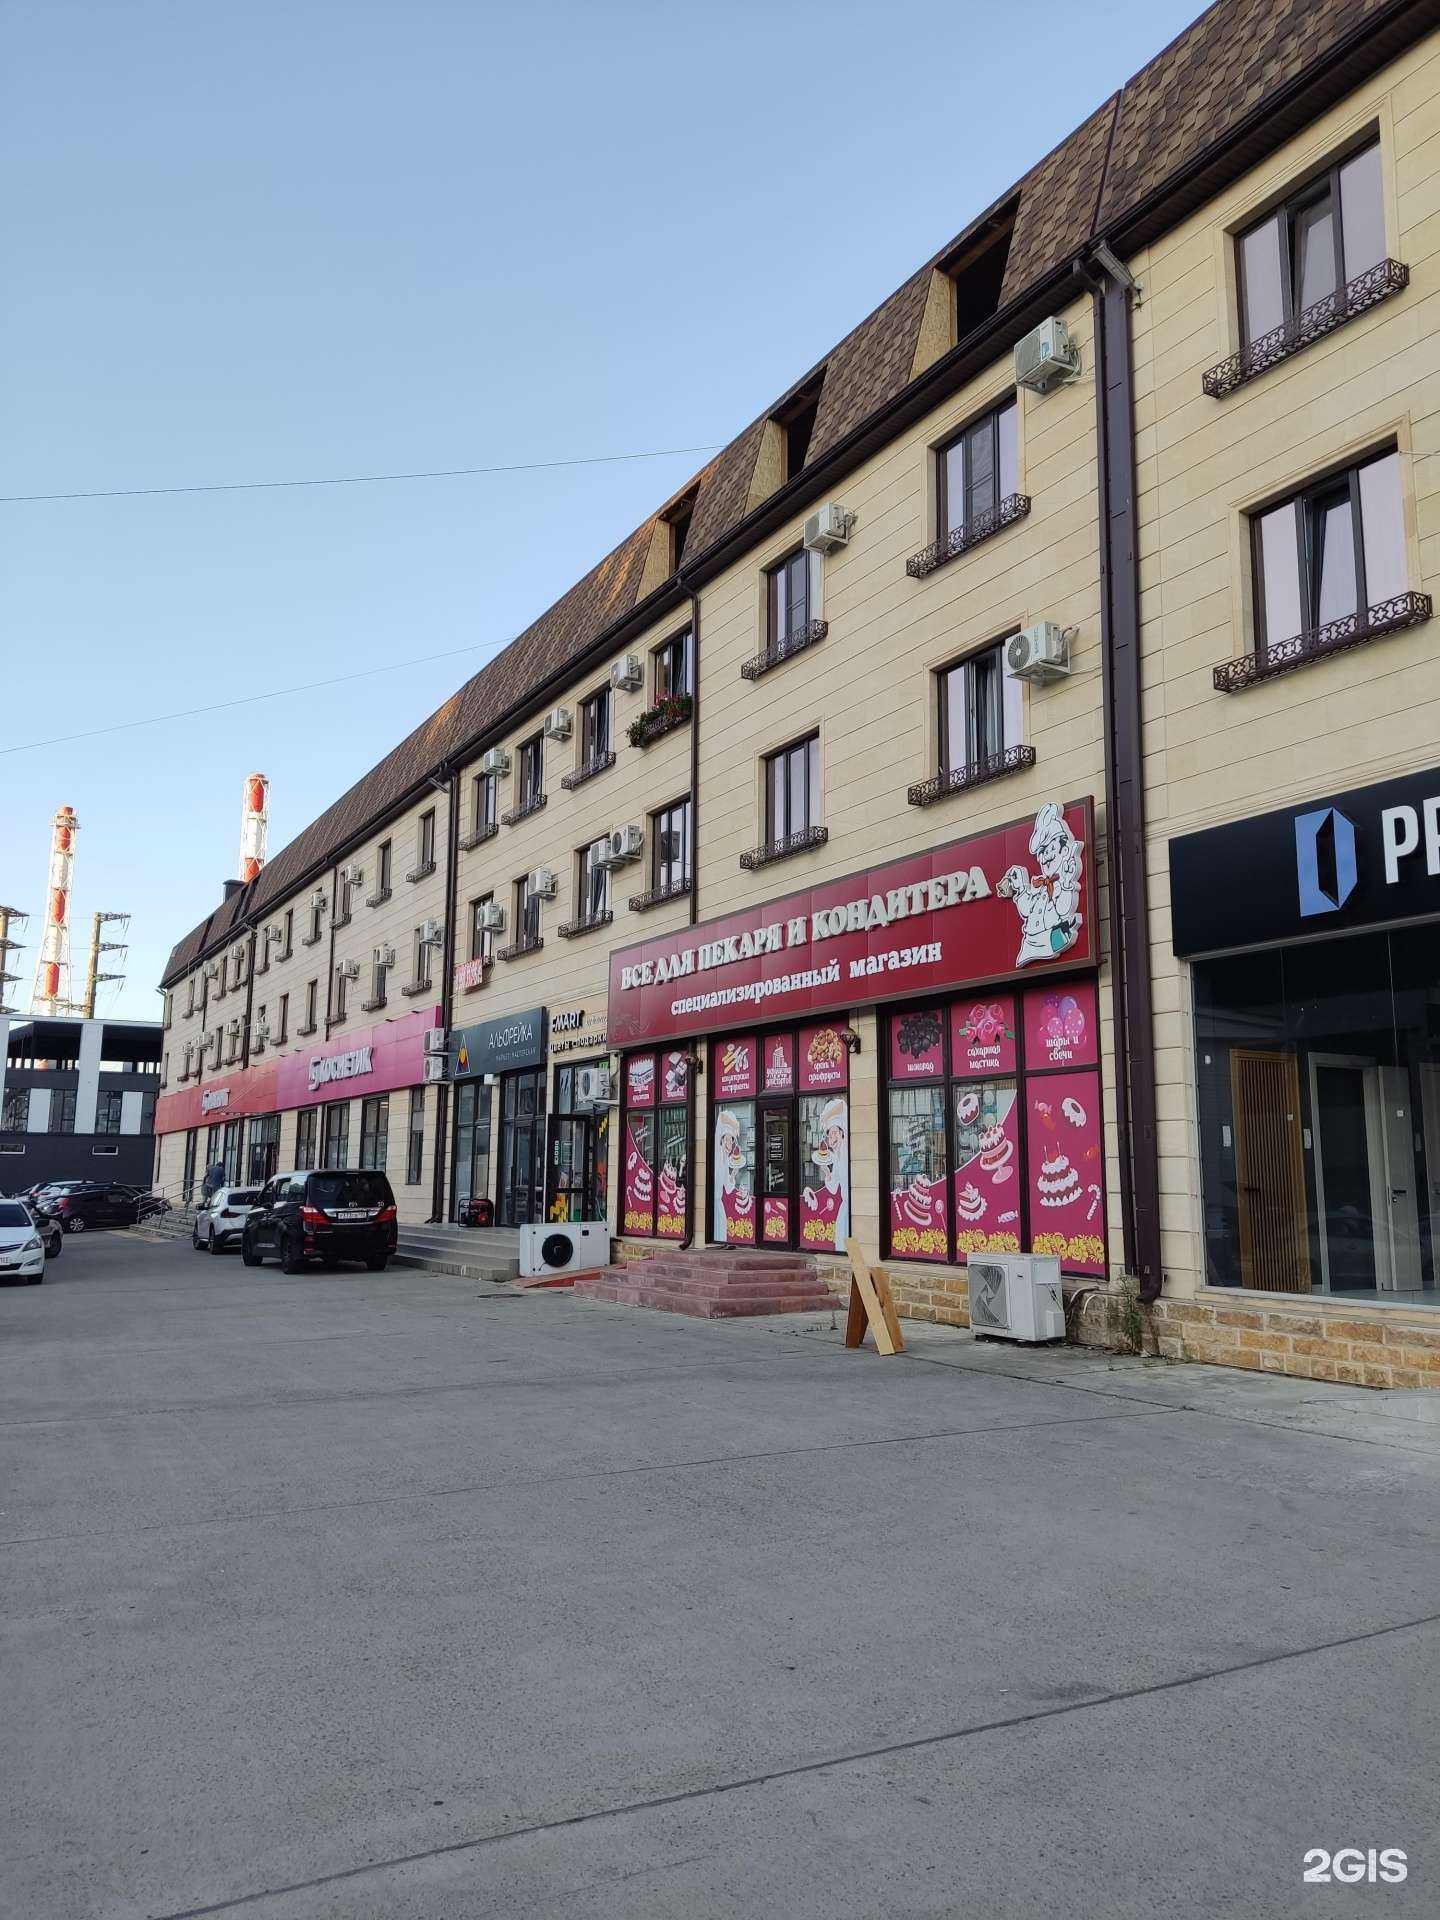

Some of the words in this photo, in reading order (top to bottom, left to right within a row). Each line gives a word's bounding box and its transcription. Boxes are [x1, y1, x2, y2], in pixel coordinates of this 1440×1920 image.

[620, 960, 654, 991] ВСЕ
[653, 949, 696, 985] ДЛЯ
[697, 923, 784, 972] ПЕКАРЯ
[787, 916, 808, 947] И
[811, 866, 992, 942] КОНДИТЕРА
[671, 958, 841, 1015] специализированный
[849, 942, 943, 978] магазин
[1046, 1036, 1070, 1050] шары
[1072, 1035, 1080, 1045] и
[967, 1045, 1001, 1058] сахарная
[1049, 1048, 1073, 1061] свечи
[969, 1058, 1000, 1069] мастика
